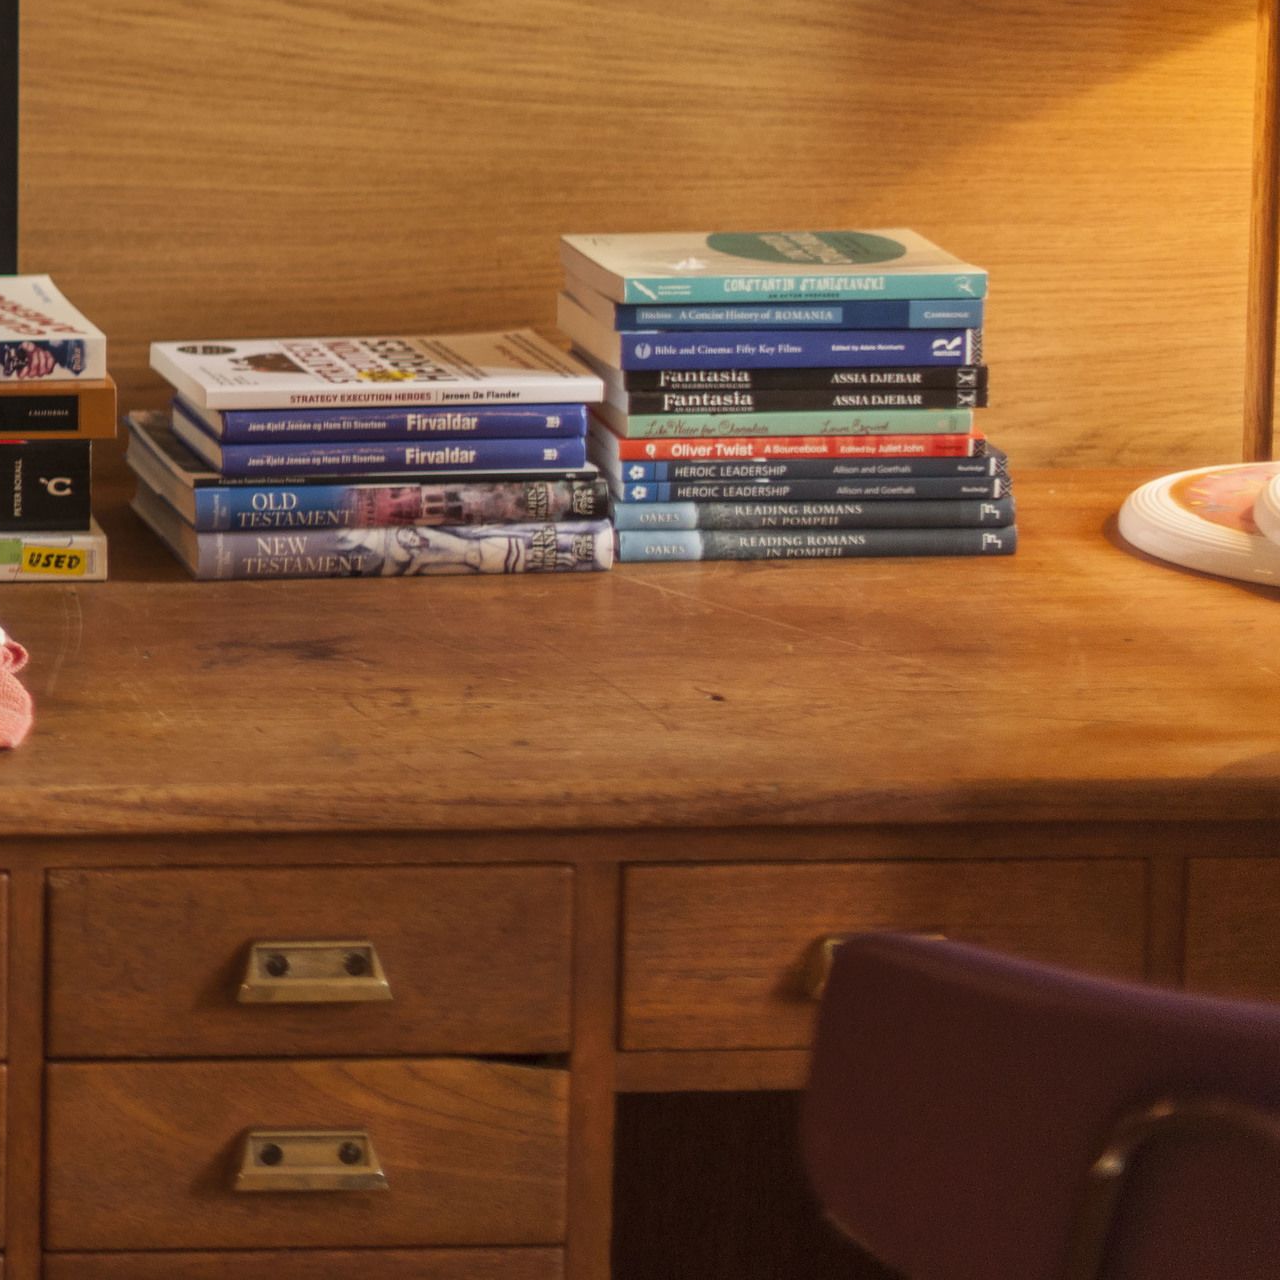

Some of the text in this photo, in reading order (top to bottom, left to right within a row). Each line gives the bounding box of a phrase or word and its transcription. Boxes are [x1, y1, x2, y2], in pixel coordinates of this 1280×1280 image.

[724, 276, 886, 293] CONSTANTIN STANISLAVSKI
[679, 311, 688, 320] A
[689, 311, 725, 320] Concise
[726, 310, 759, 321] History
[759, 310, 771, 319] of
[775, 310, 833, 320] ROMANIA
[655, 346, 677, 356] Bible
[679, 346, 695, 355] and
[736, 344, 756, 356] Fifty
[759, 344, 775, 356] Key
[778, 343, 802, 354] Films
[660, 370, 751, 387] Fantasia
[831, 372, 923, 384] ASSIA DJEBAR
[290, 391, 432, 404] STRATEGY EXECUTION HEROES
[441, 390, 521, 402] Jeroen De Flander
[663, 391, 754, 411] Fantasia
[833, 394, 923, 406] ASSIA DJEBAR
[406, 415, 479, 431] Firvaldar
[405, 447, 477, 464] Firvaldar
[671, 444, 712, 457] Oliver
[714, 443, 754, 457] Twist
[763, 445, 772, 454] A
[773, 444, 828, 454] Sourcebook
[878, 443, 904, 453] Juliet
[905, 443, 925, 453] John
[675, 465, 788, 478] HEROIC LEADERSHIP
[860, 465, 876, 474] and
[677, 486, 791, 498] HEROIC LEADERSHIP
[864, 486, 879, 495] and
[251, 492, 297, 511] OLD
[735, 503, 864, 516] READING ROMANS
[237, 510, 355, 529] TESTAMENT
[639, 512, 680, 524] OAKES
[761, 515, 840, 526] IN POMPEII
[256, 535, 309, 556] NEW
[739, 534, 868, 548] READING ROMANS
[644, 543, 686, 555] OAKES
[766, 547, 843, 558] IN POMPEII
[28, 552, 80, 570] USED
[242, 555, 368, 574] TESTAMENT
